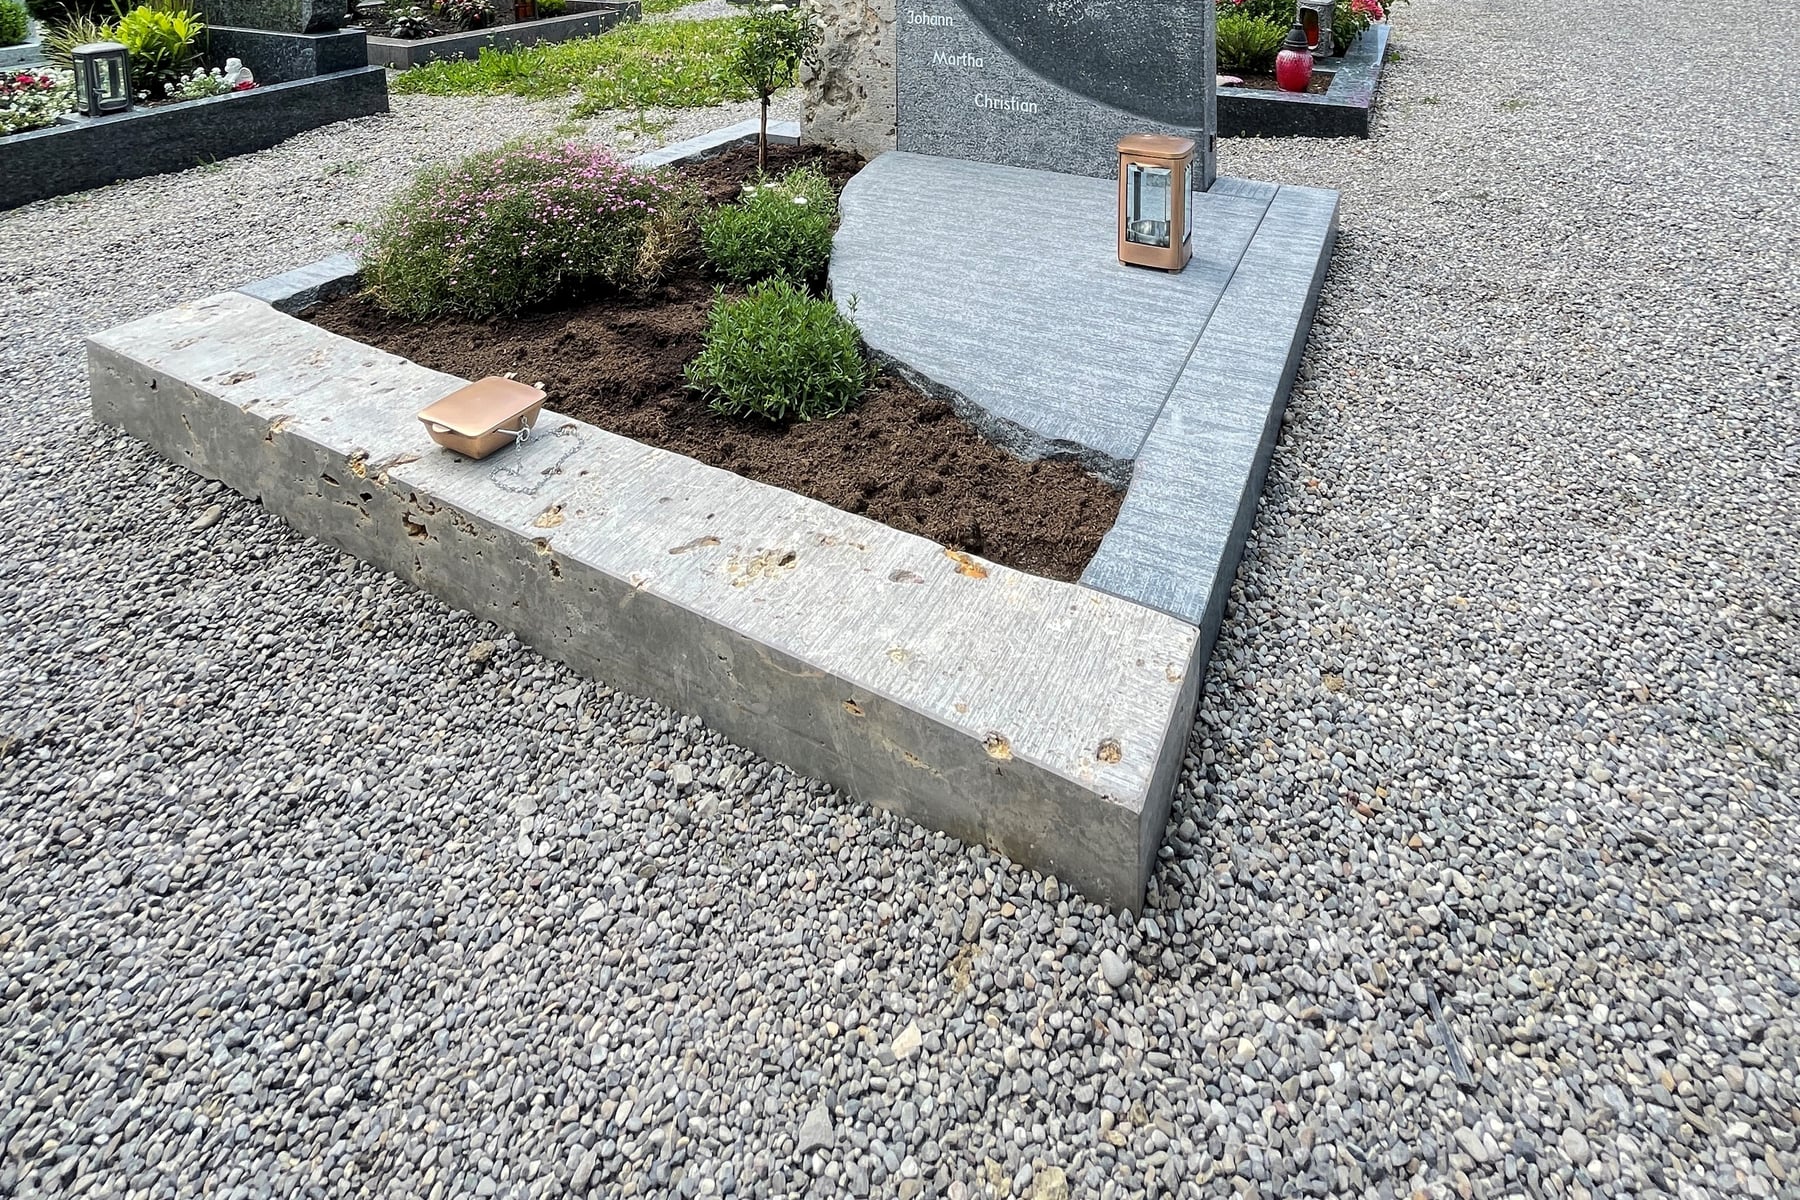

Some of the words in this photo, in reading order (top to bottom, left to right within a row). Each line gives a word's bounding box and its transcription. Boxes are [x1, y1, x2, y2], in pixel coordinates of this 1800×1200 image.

[907, 10, 953, 26] Johann
[932, 51, 984, 68] Martha
[974, 93, 1038, 114] Christian
